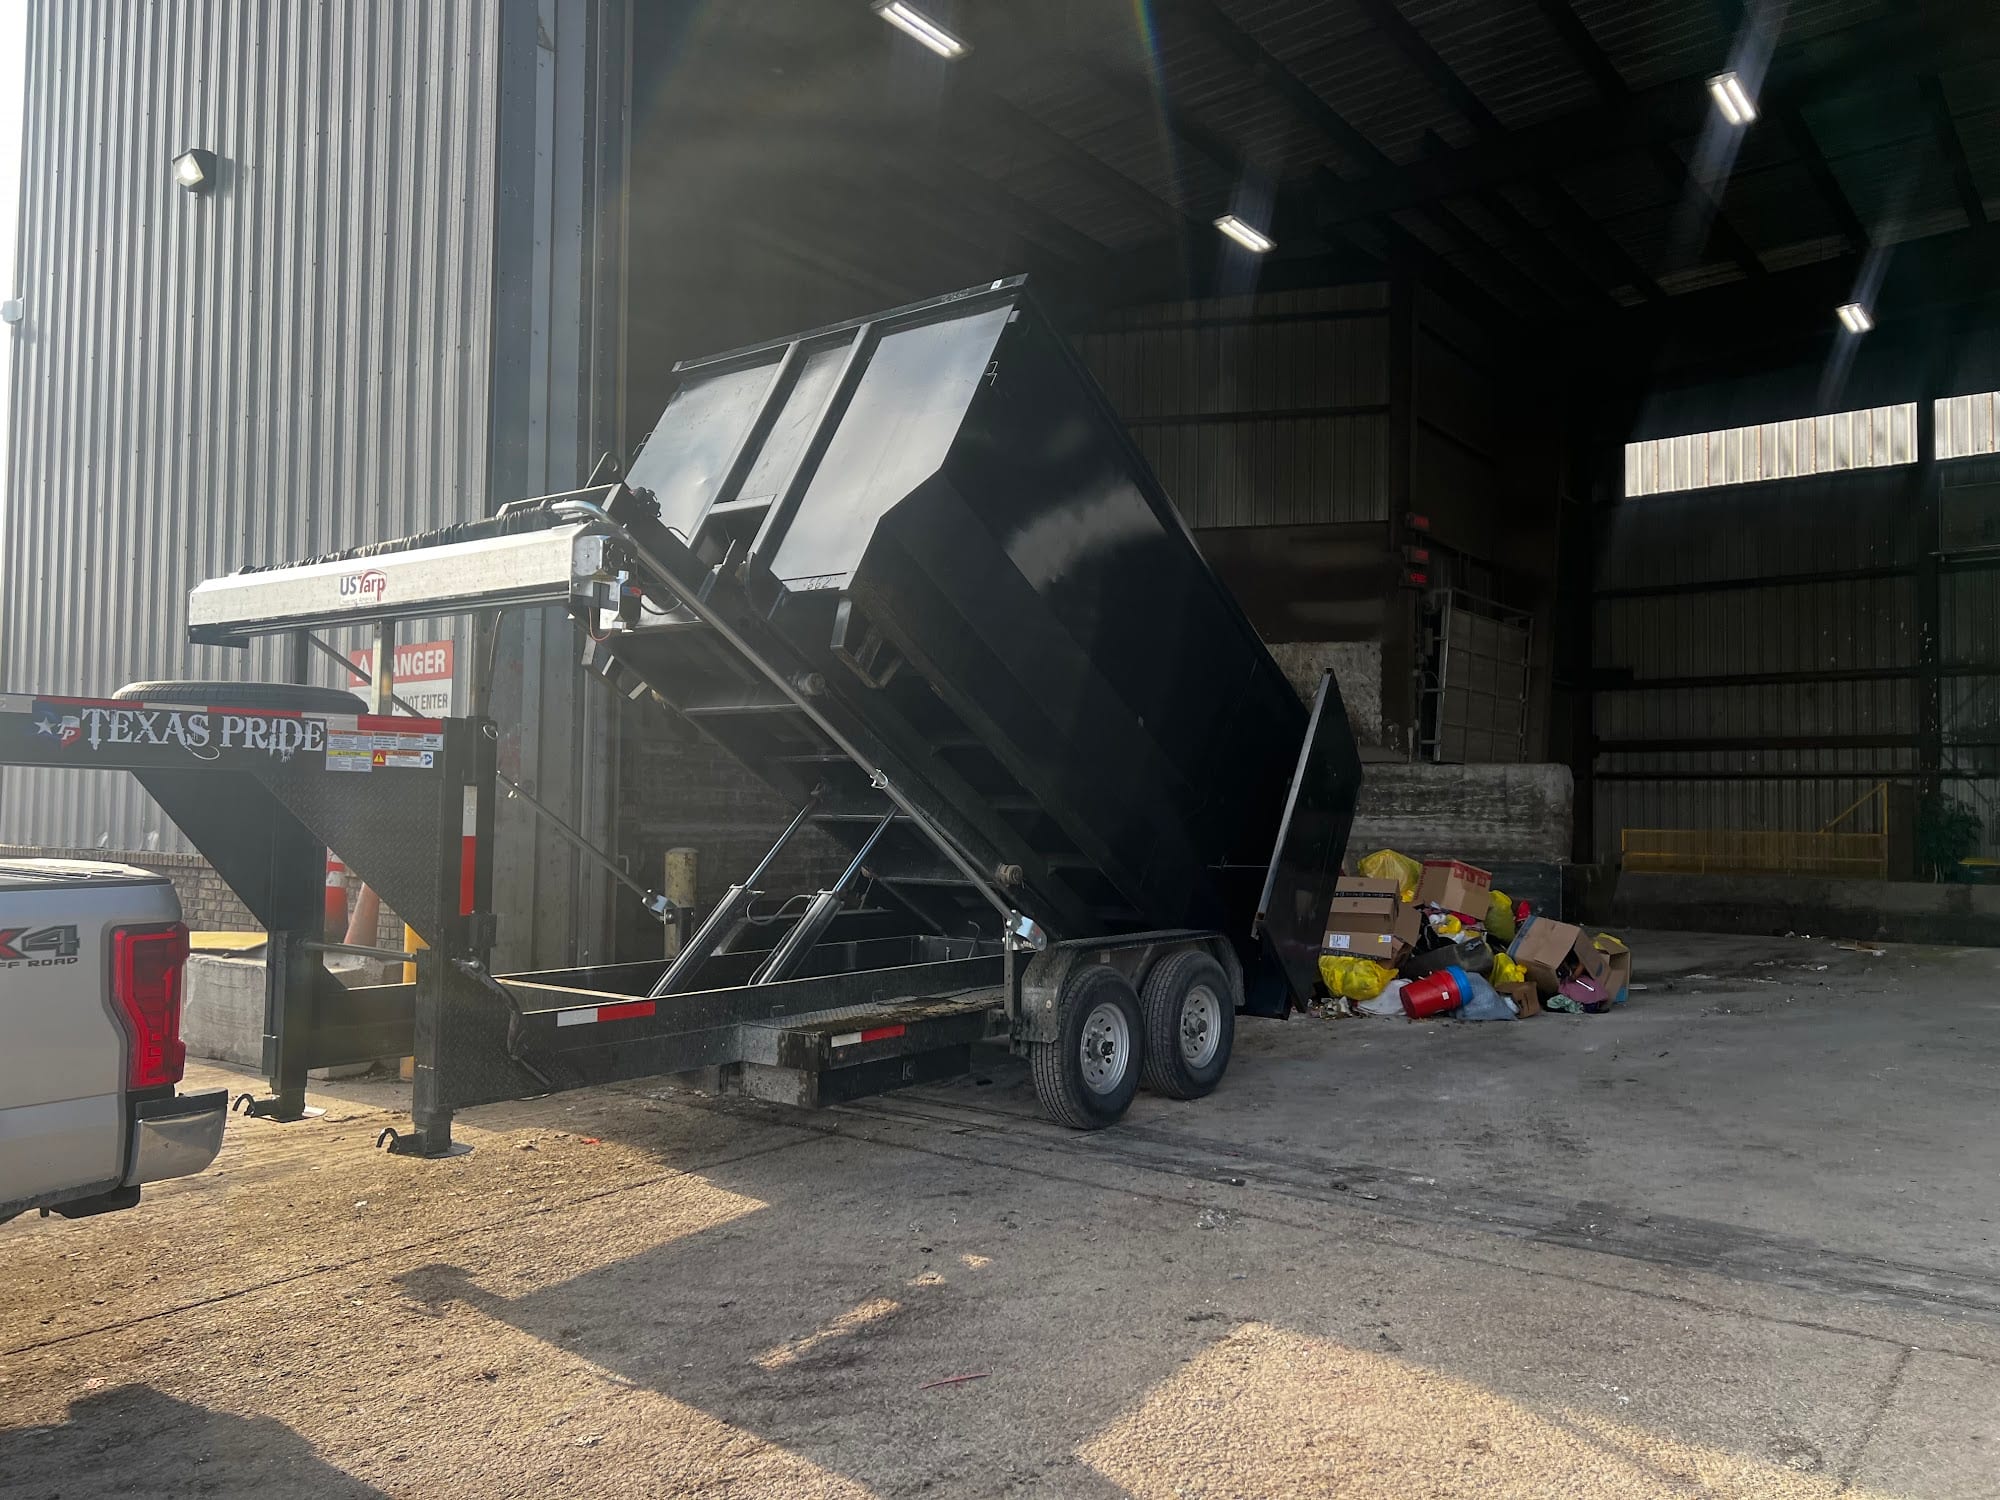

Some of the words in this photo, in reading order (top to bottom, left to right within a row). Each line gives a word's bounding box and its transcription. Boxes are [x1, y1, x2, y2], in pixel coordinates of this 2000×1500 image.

[393, 649, 446, 677] ANGER
[421, 693, 448, 710] ENTER
[81, 708, 211, 752] TEXAS
[220, 715, 325, 756] PRIDE
[28, 957, 78, 967] ROAD
